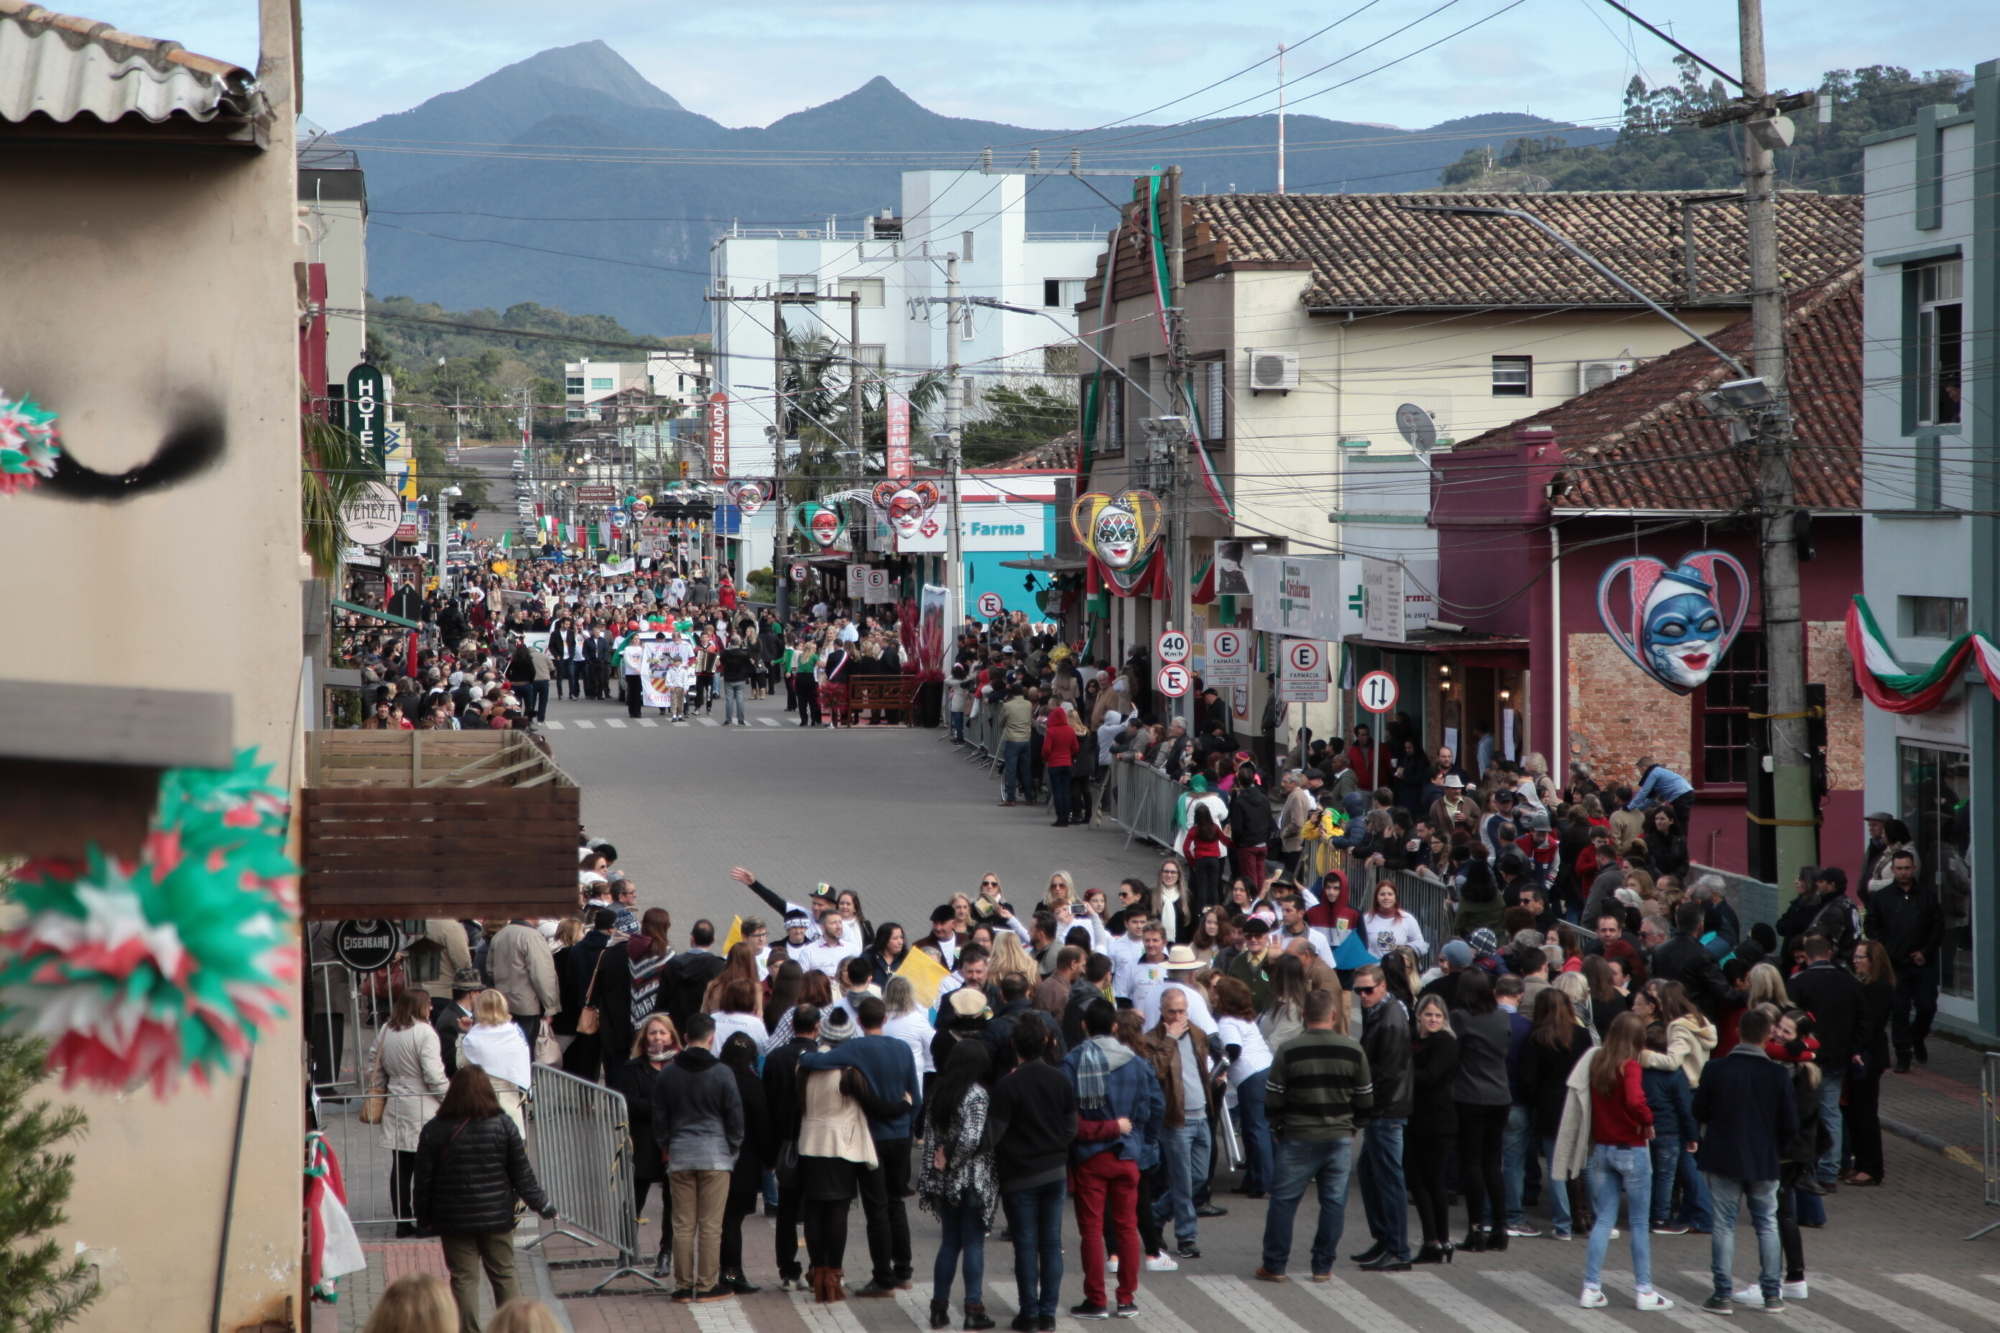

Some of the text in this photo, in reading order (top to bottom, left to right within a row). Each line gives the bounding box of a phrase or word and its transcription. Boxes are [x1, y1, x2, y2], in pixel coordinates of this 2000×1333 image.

[713, 400, 725, 462] BERLANDA
[343, 503, 398, 523] VENEZA
[971, 522, 1025, 536] Farma
[856, 569, 863, 578] E
[873, 574, 879, 584] E
[985, 598, 995, 611] E
[1163, 637, 1185, 650] 40
[1221, 637, 1231, 652] E
[1299, 649, 1310, 665] E
[1168, 671, 1181, 689] E
[343, 935, 389, 950] EISENBAHN
